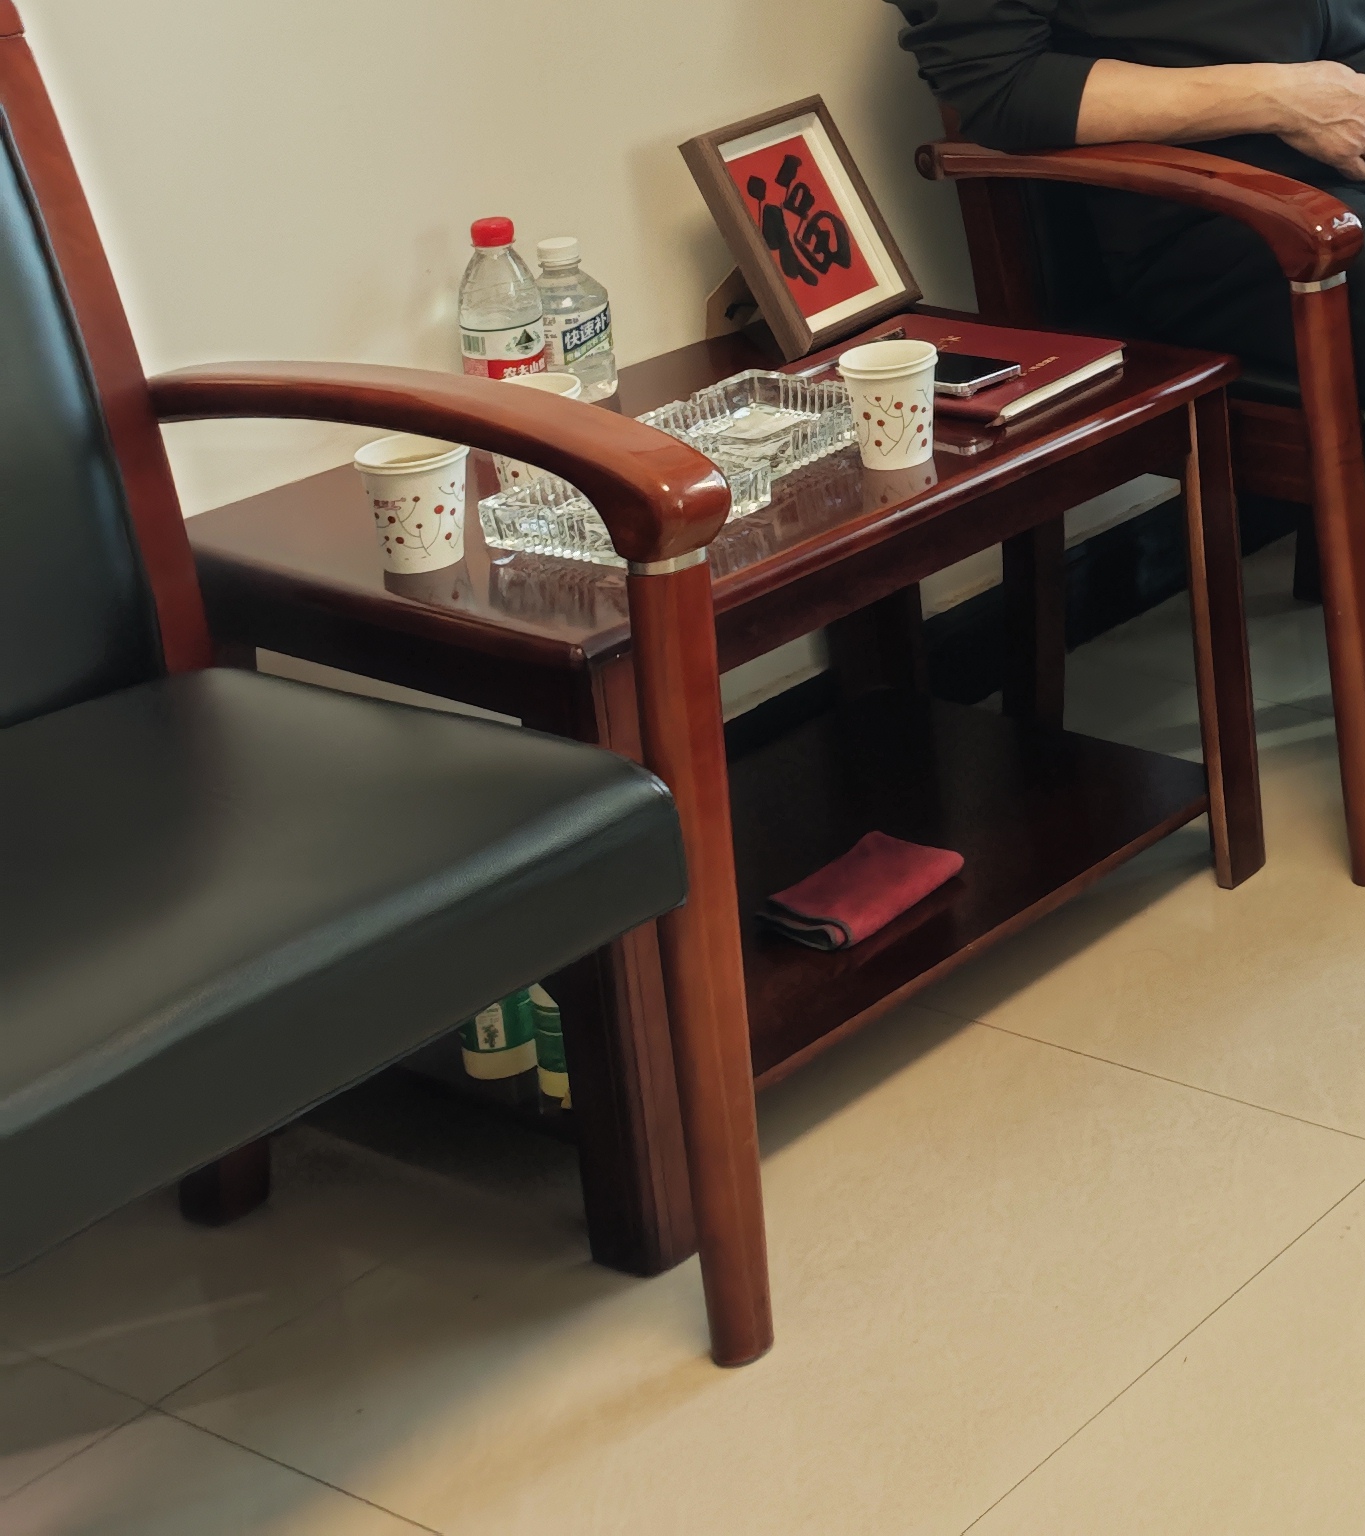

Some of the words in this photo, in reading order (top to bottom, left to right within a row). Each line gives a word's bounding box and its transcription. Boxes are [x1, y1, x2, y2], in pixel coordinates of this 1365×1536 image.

[747, 154, 852, 287] 福
[565, 310, 610, 350] 快速补
